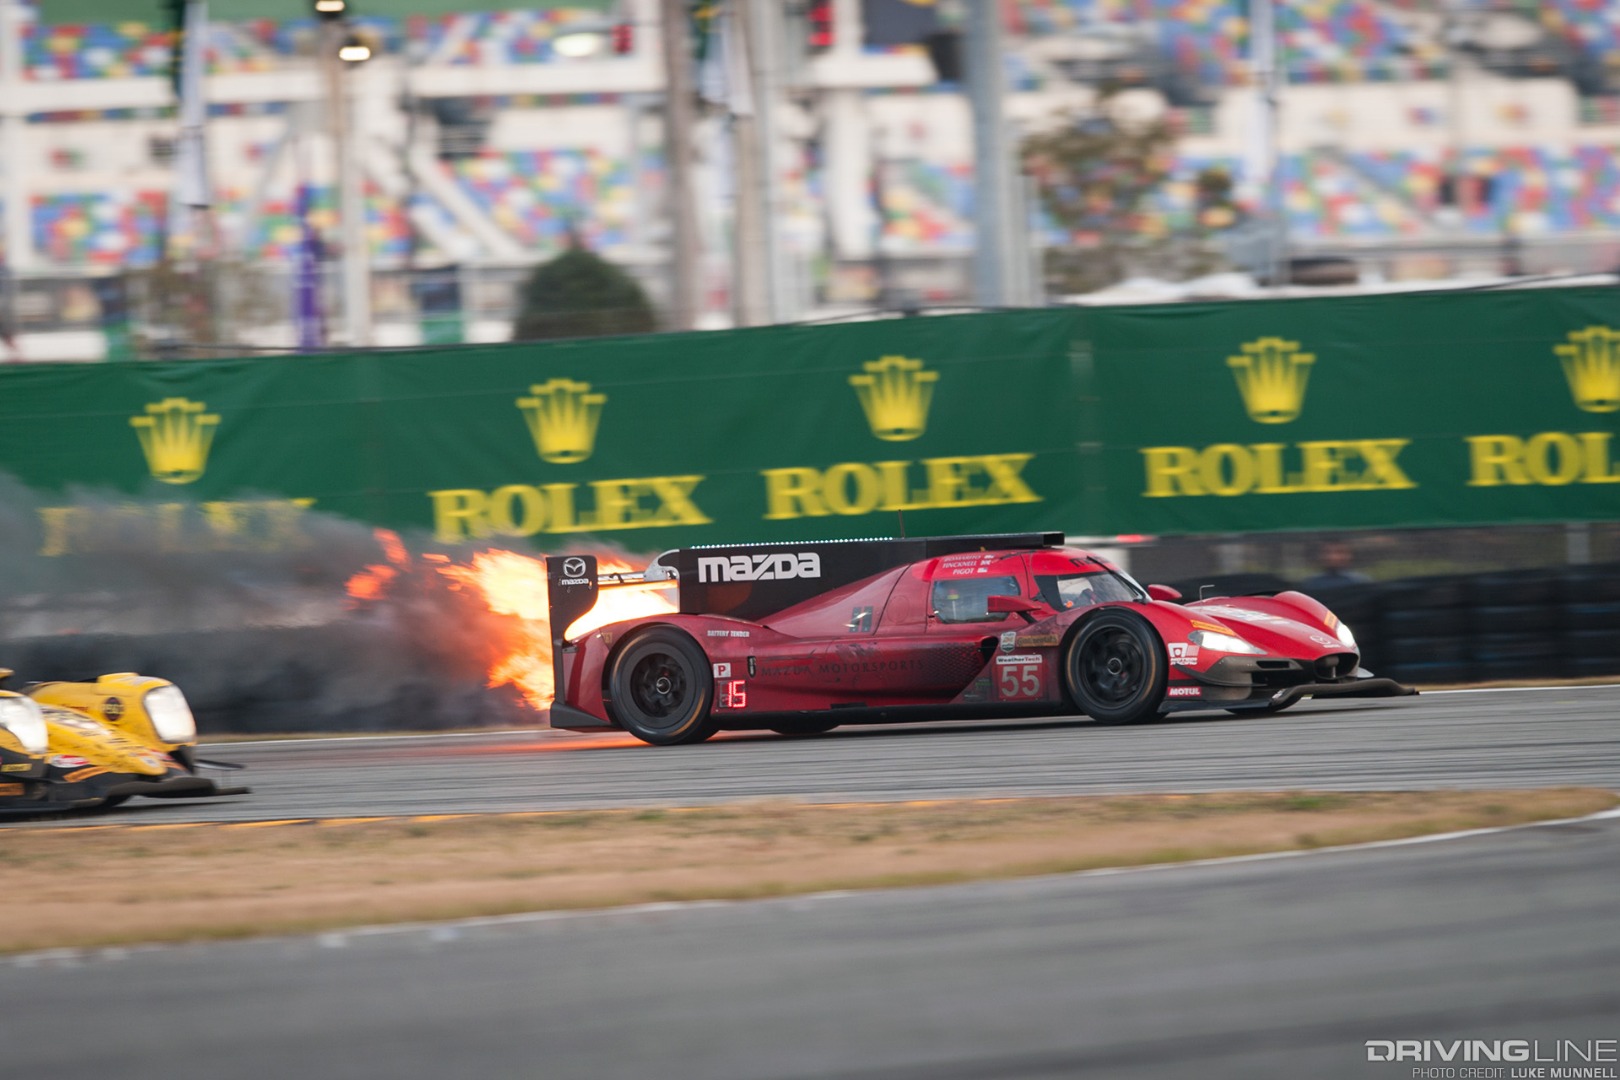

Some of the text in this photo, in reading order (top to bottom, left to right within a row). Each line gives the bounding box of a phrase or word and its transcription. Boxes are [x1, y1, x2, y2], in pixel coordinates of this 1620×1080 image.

[1138, 437, 1418, 497] ROLEX
[760, 452, 1044, 520] ROLEX
[428, 474, 712, 544] ROLEX
[952, 567, 975, 575] PIGOT
[717, 665, 727, 676] P
[761, 660, 925, 676] MAZDA MOTORSPORTS
[1001, 665, 1040, 697] 55
[1169, 688, 1201, 696] MOTUL
